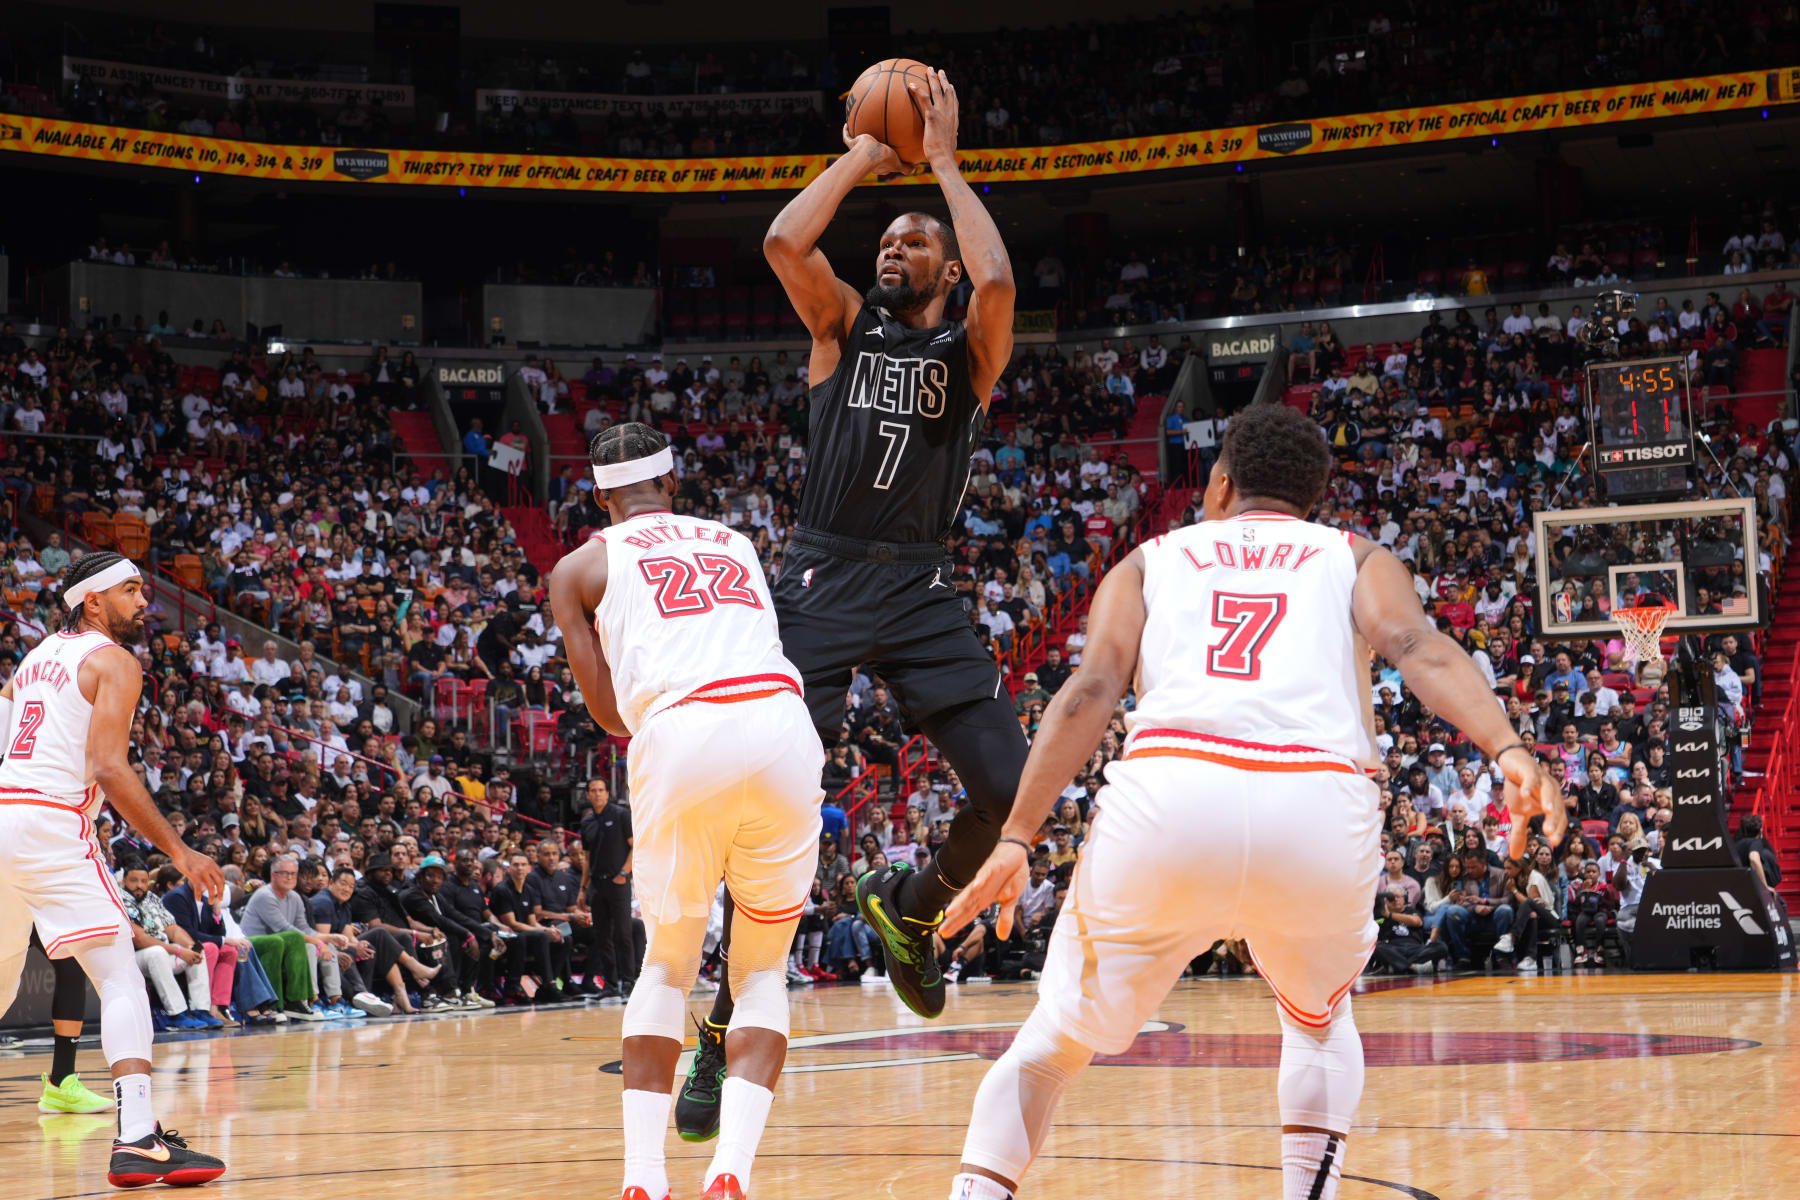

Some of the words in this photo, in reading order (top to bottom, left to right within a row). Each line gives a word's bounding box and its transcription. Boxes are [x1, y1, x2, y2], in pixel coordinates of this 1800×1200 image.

[72, 64, 106, 78] NEED
[110, 67, 194, 88] ASSISTANCE?
[199, 80, 229, 93] TEXT
[234, 83, 250, 95] US
[256, 86, 272, 97] AT
[485, 95, 518, 106] NEED
[523, 97, 608, 111] ASSISTANCE?
[612, 101, 643, 112] TEXT
[647, 102, 664, 113] US
[668, 101, 687, 112] AT
[1321, 122, 1383, 142] THIRSTY?
[1389, 120, 1415, 135] TRY
[1418, 116, 1443, 131] THE
[1449, 109, 1507, 128] OFFICIAL
[1513, 104, 1559, 122] CRAFT
[1564, 100, 1601, 116] BEER
[1606, 97, 1626, 111] OF
[1630, 93, 1656, 108] THE
[1662, 88, 1711, 105] MIAMI
[1716, 82, 1756, 99] HEAT
[35, 128, 106, 149] AVAILABLE
[110, 138, 128, 153] AT
[133, 141, 193, 160] SECTIONS
[199, 149, 222, 165] 110,
[226, 152, 249, 168] 114,
[254, 154, 277, 169] 314
[282, 157, 293, 170] &
[300, 157, 323, 170] 319
[958, 157, 1027, 173] AVAILABLE
[1031, 156, 1049, 171] AT
[1053, 151, 1113, 169] SECTIONS
[1118, 149, 1141, 163] 110,
[1146, 147, 1170, 160] 114,
[1176, 142, 1198, 156] 314
[1203, 141, 1214, 154] &
[1220, 139, 1243, 152] 319
[404, 161, 464, 176] THIRSTY?
[470, 164, 494, 177] TRY
[498, 165, 522, 178] THE
[526, 166, 581, 180] OFFICIAL
[586, 168, 629, 182] CRAFT
[634, 169, 667, 183] BEER
[672, 169, 690, 183] OF
[693, 168, 718, 181] THE
[722, 167, 765, 181] MIAMI
[770, 165, 806, 179] HEAT
[1212, 334, 1275, 357] BACARDÍ
[439, 365, 503, 383] BACARDÍ
[847, 351, 948, 418] NETS
[1619, 367, 1674, 392] 4:55
[873, 420, 910, 490] 7
[1624, 444, 1687, 461] TISSOT
[622, 525, 732, 550] BUTLER
[1180, 540, 1325, 572] LOWRY
[637, 552, 766, 619] 22
[1206, 590, 1288, 681] 7
[16, 660, 71, 693] VINCENT
[1679, 707, 1704, 718] BIO
[8, 701, 46, 759] 2
[1672, 836, 1723, 851] KIA
[1651, 902, 1720, 916] American
[1665, 916, 1722, 929] Airlines
